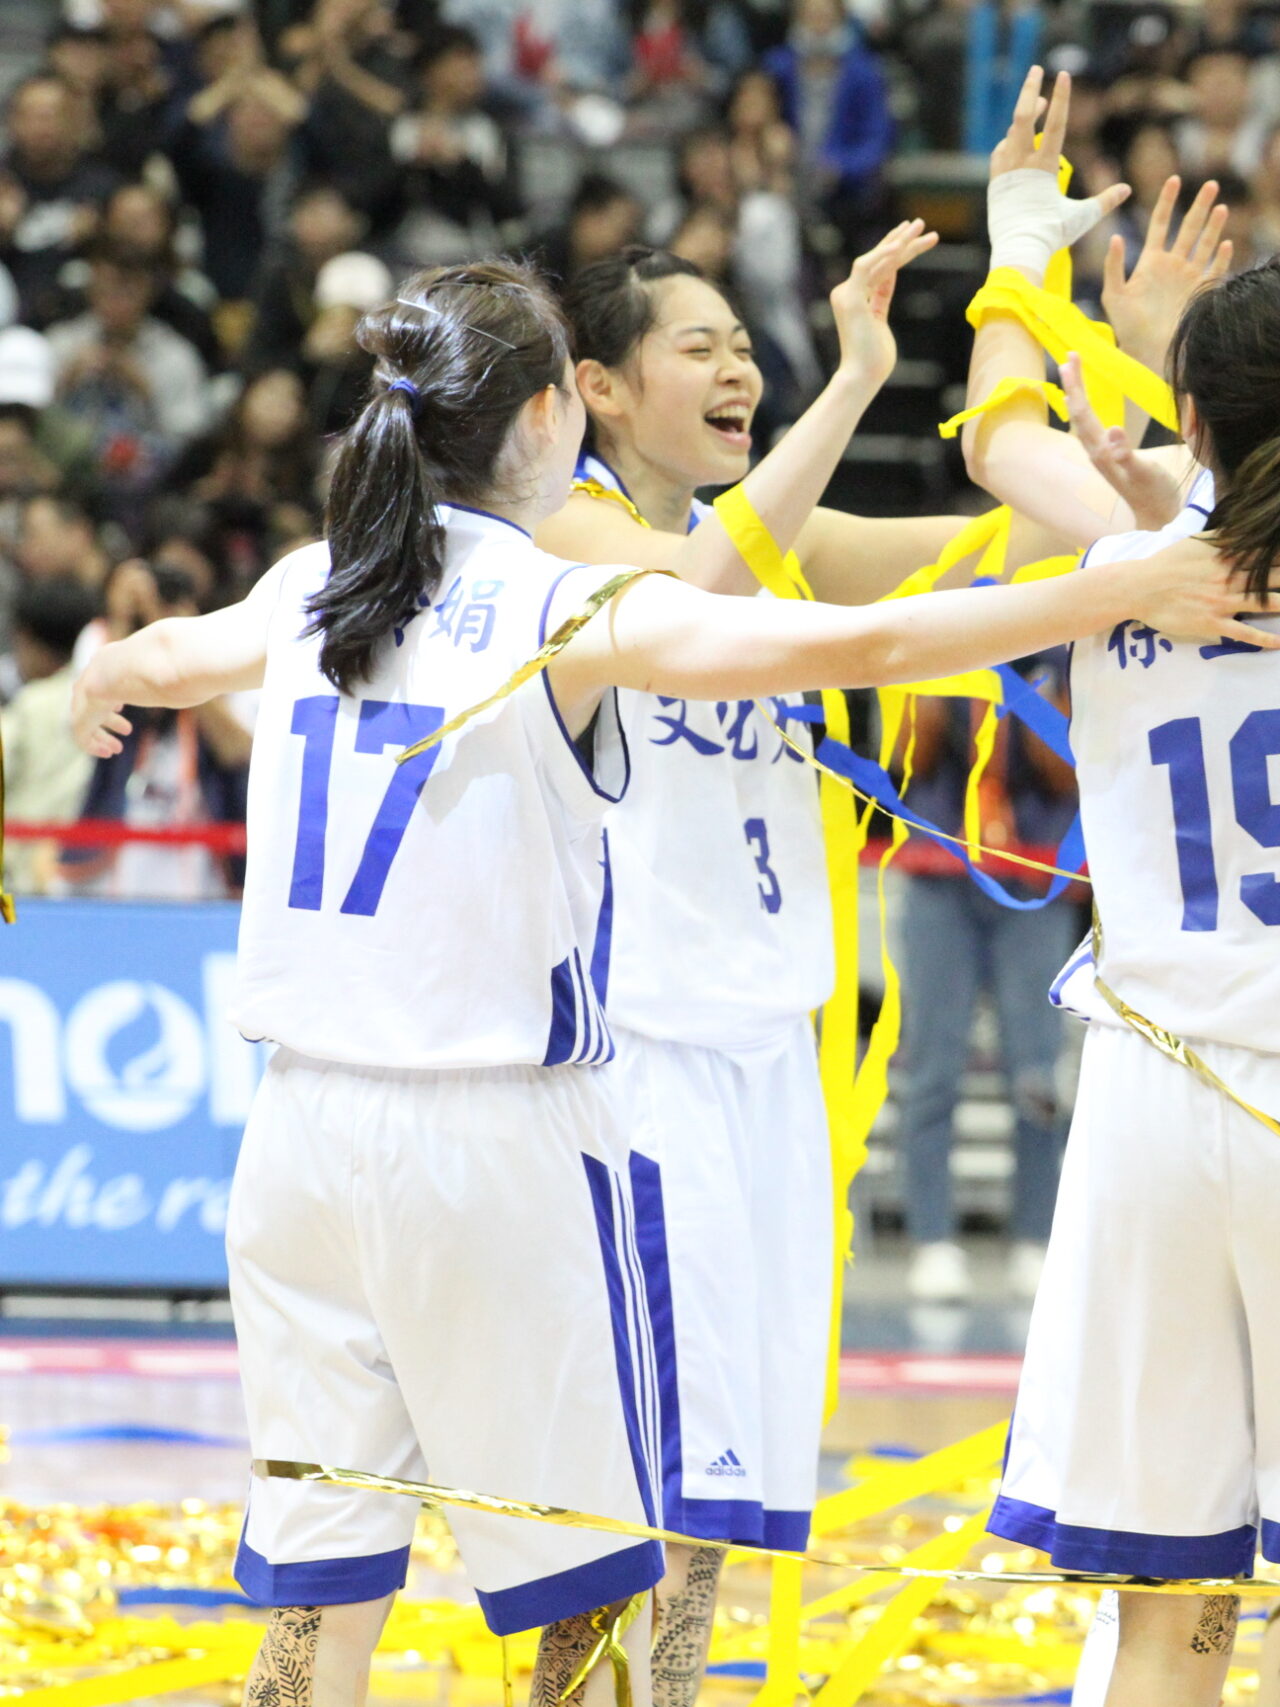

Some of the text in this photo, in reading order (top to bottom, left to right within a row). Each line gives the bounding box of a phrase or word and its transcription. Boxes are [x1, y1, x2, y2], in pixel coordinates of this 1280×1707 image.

[288, 694, 446, 916] 17
[743, 817, 783, 914] 3
[0, 1143, 148, 1231] the
[704, 1466, 747, 1477] adidas
